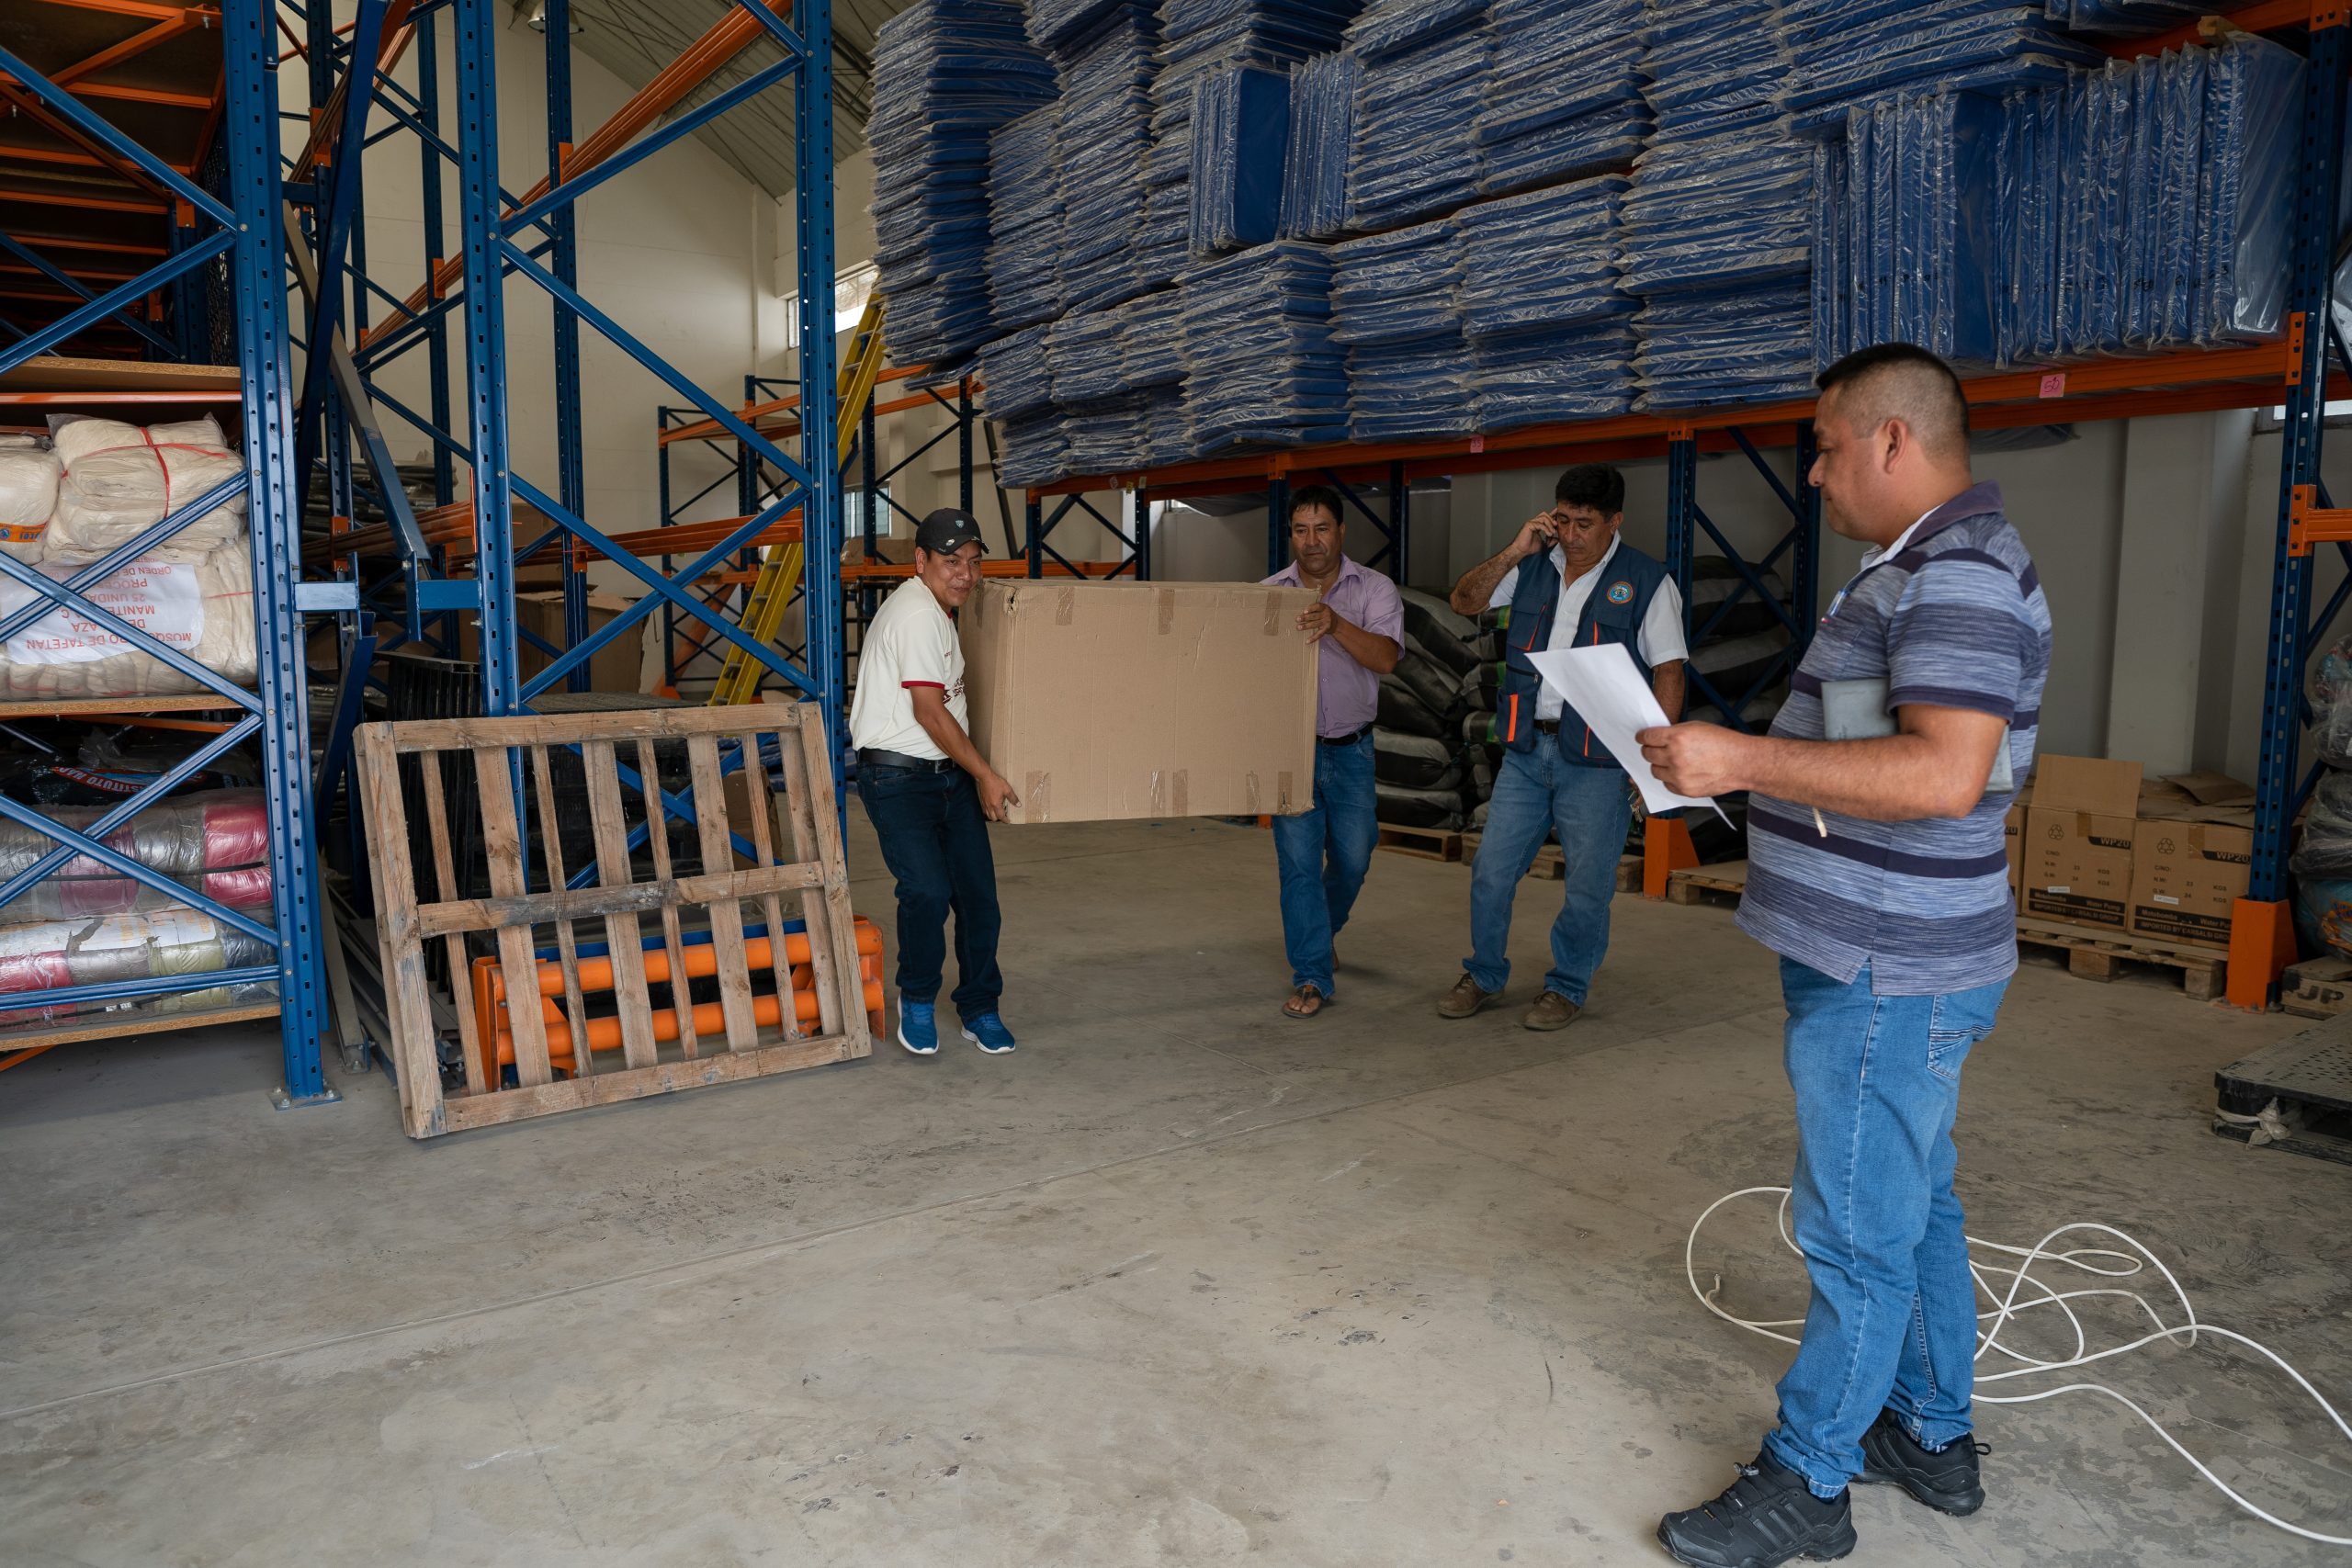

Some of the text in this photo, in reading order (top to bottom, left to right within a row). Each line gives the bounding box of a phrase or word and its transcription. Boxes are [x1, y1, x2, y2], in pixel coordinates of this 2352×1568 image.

[138, 566, 172, 576] ORDEN
[26, 637, 84, 650] TAFETAN
[88, 635, 105, 646] DE
[2100, 837, 2130, 848] WP20
